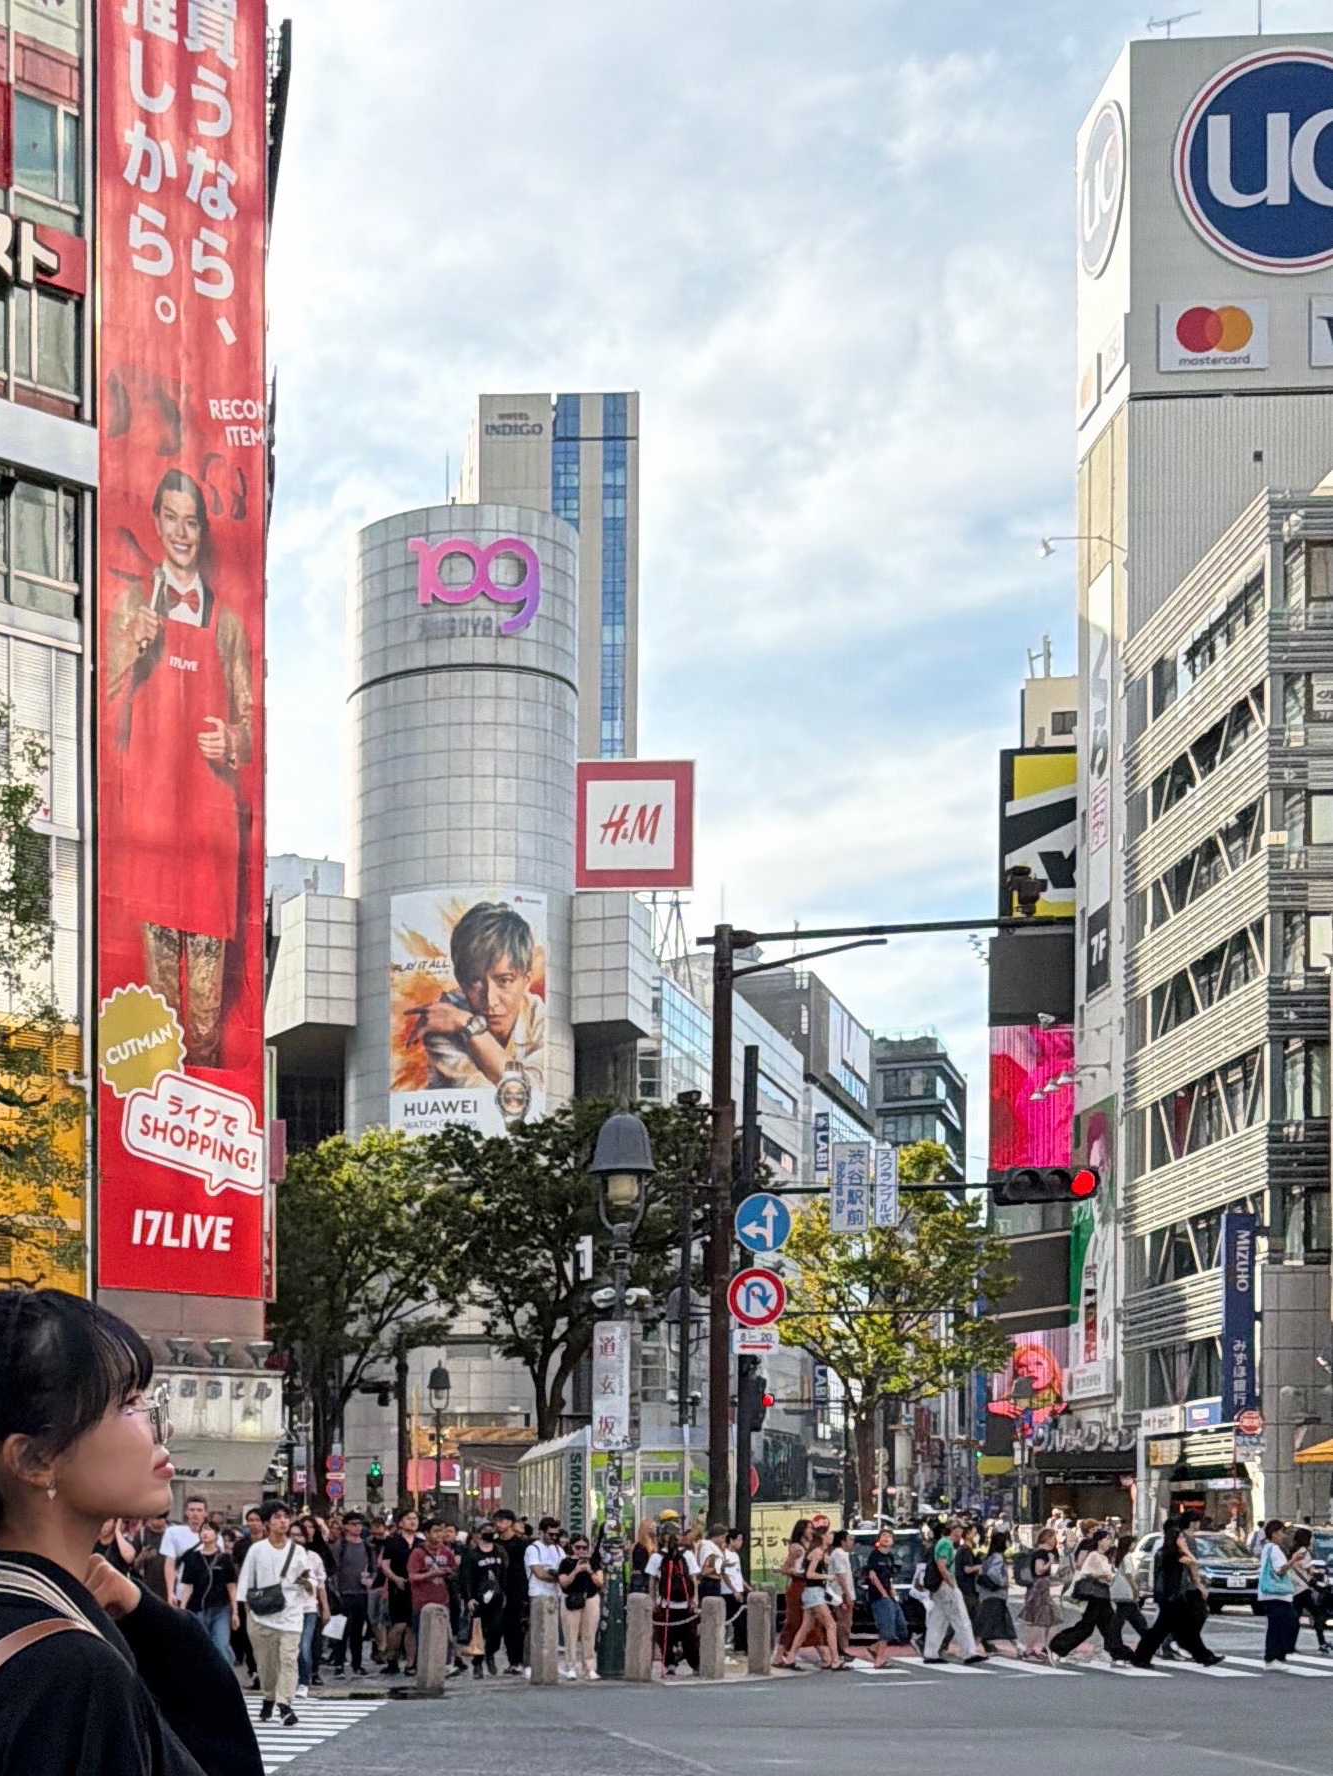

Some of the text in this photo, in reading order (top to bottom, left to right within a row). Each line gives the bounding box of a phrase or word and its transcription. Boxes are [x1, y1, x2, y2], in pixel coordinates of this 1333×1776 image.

[1178, 354, 1251, 366] mastercard
[485, 423, 543, 435] INDIGO
[408, 537, 541, 636] 109
[599, 803, 663, 846] H&M
[105, 1023, 174, 1065] CUTMAN
[167, 1094, 239, 1138] ライブで
[404, 1100, 478, 1117] HUAWEI
[138, 1113, 258, 1173] SHOPPING!
[848, 1148, 865, 1226] 渋谷駅前
[879, 1151, 893, 1223] スクランブル式
[132, 1208, 234, 1252] 17LIVE
[1236, 1230, 1250, 1292] MIZUHO
[598, 1335, 617, 1436] 道玄坂
[1233, 1339, 1247, 1406] みずほ銀行
